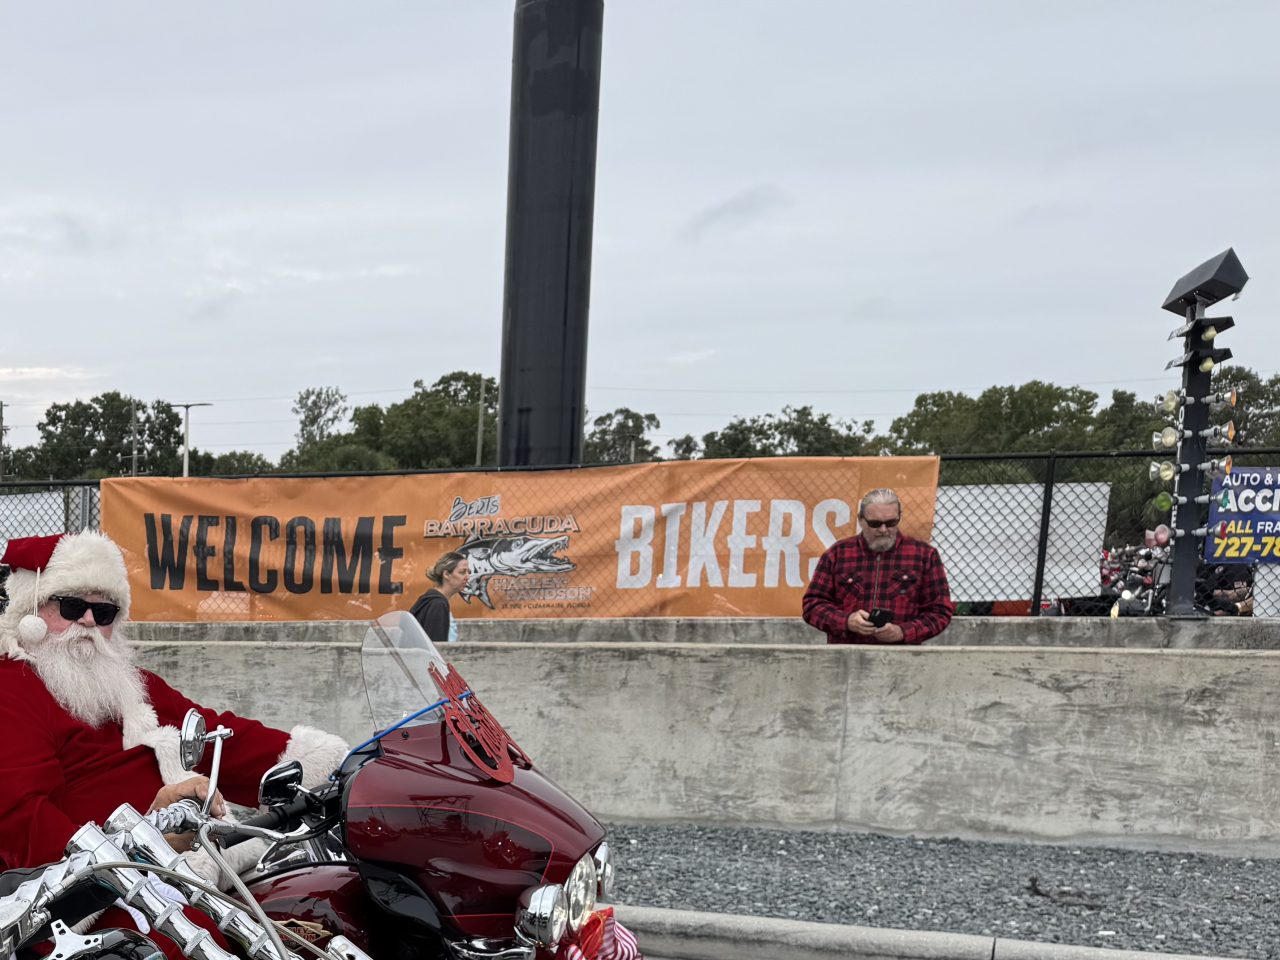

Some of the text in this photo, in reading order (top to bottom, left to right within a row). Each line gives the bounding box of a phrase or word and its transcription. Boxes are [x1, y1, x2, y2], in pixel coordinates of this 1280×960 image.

[1222, 473, 1273, 487] AUTO &
[424, 514, 581, 539] BARRACUDA
[1223, 519, 1254, 534] ALL
[144, 512, 407, 595] WELCOME
[615, 499, 862, 589] BIKERS
